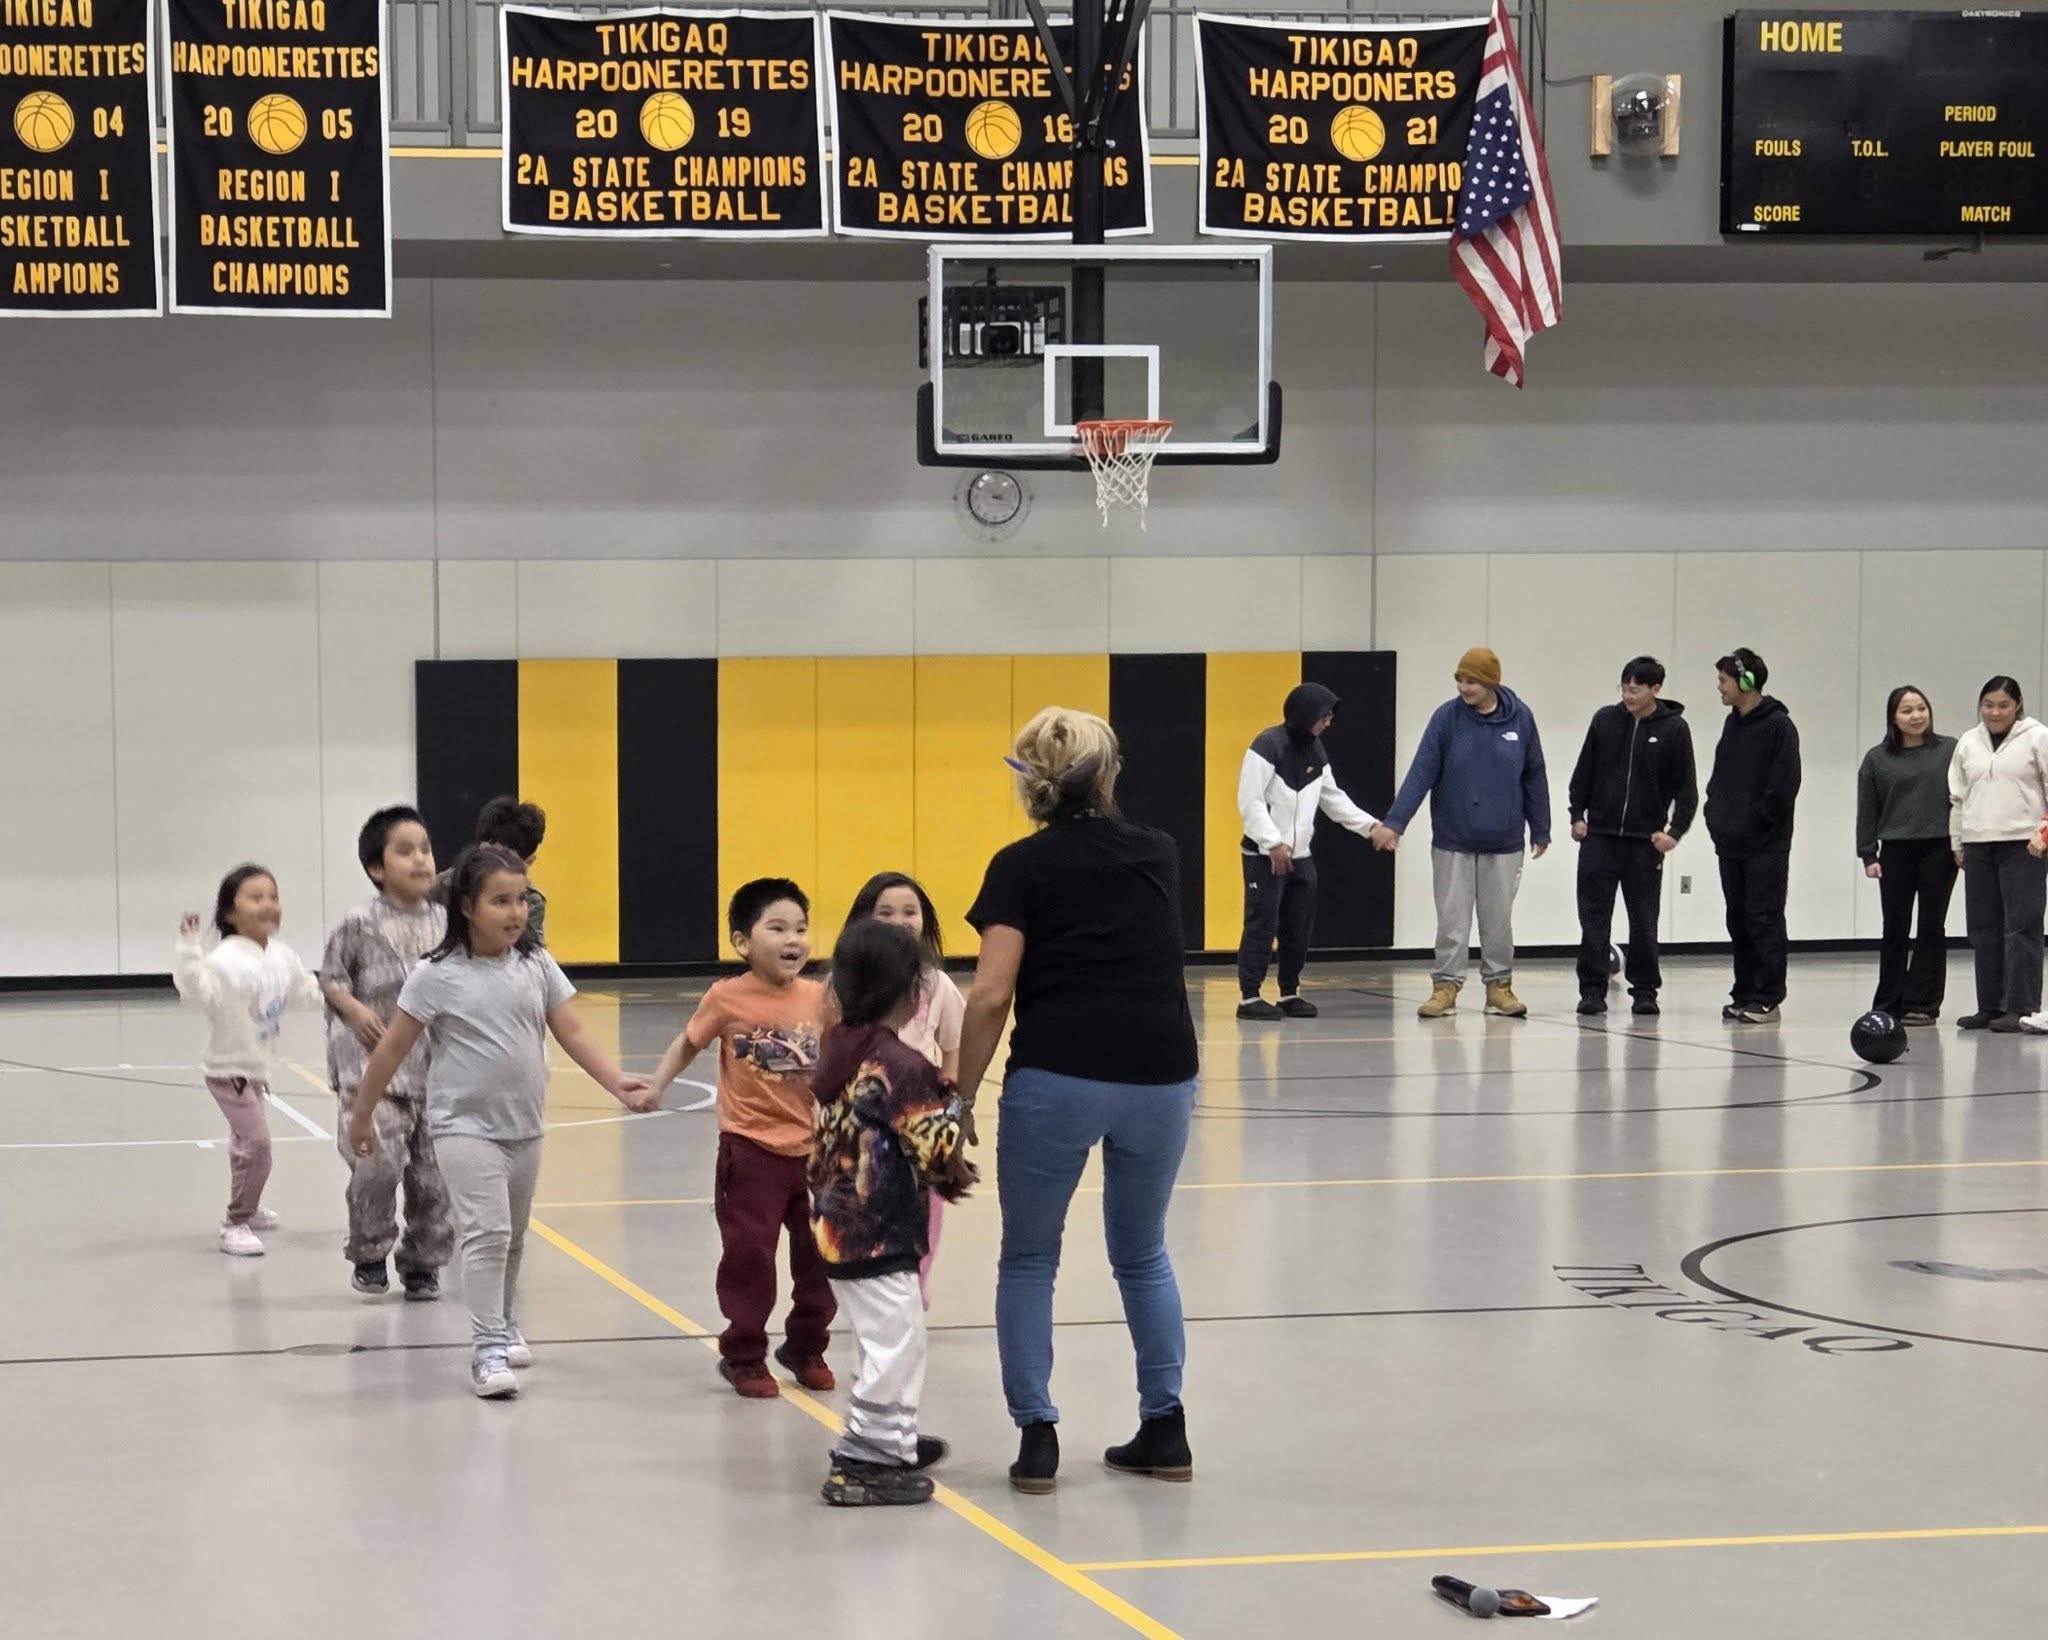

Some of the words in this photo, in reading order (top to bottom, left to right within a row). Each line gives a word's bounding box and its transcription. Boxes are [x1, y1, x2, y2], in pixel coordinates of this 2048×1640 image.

[222, 0, 325, 31] TIKIGAQ
[596, 22, 727, 55] TIKIGAQ
[1288, 36, 1417, 68] TIKIGAQ
[1761, 21, 1843, 52] HOME
[171, 41, 377, 78] HARPOONERETTES
[512, 56, 808, 91] HARPOONERETTES
[1250, 66, 1456, 101] HARPOONERS
[94, 106, 123, 138] 04
[204, 105, 233, 137] 20
[322, 108, 352, 139] 05
[576, 109, 617, 138] 20
[718, 108, 750, 137] 19
[903, 113, 943, 142] 20
[1945, 106, 1996, 121] PERIOD
[1269, 115, 1308, 144] 20
[1407, 116, 1437, 145] 21
[1756, 140, 1801, 156] FOULS
[1852, 140, 1888, 156] T.O.L.
[1941, 141, 1993, 156] PLAYER
[1999, 142, 2034, 157] FOUL
[219, 169, 305, 201] REGION
[518, 154, 548, 185] 2A
[573, 157, 650, 188] STATE
[675, 156, 805, 187] CHAMPIONS
[848, 157, 877, 187] 2A
[902, 160, 978, 191] STATE
[1002, 154, 1128, 191] CHAMPNS
[1216, 158, 1244, 187] 2A
[1266, 163, 1341, 193] STATE
[1365, 161, 1461, 193] CHAMPIO
[549, 190, 780, 221] BASKETBALL
[879, 190, 1072, 224] BASKETBAL
[1754, 206, 1800, 221] SCORE
[1962, 206, 2010, 222] MATCH
[201, 215, 359, 248] BASKETBALL
[214, 262, 349, 295] CHAMPIONS
